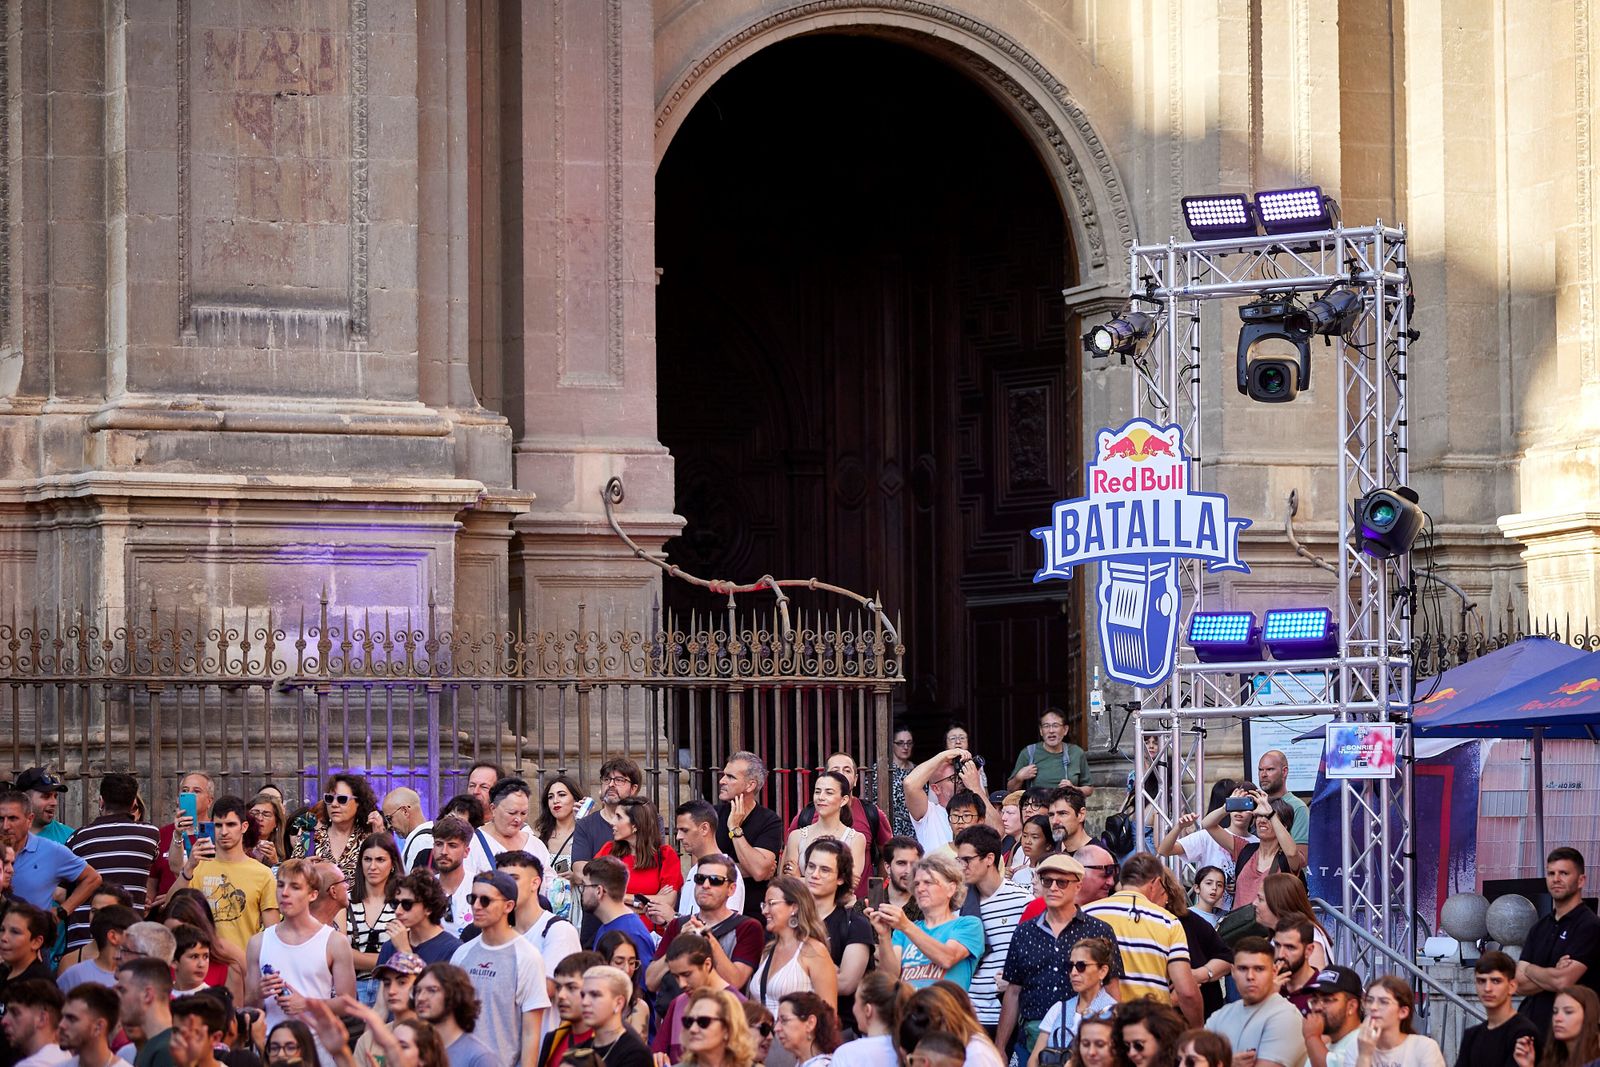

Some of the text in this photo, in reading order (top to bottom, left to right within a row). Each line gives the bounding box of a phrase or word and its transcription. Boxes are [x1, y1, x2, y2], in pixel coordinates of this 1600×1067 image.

[1094, 465, 1183, 493] Red Bull
[1061, 499, 1219, 558] BATALLA
